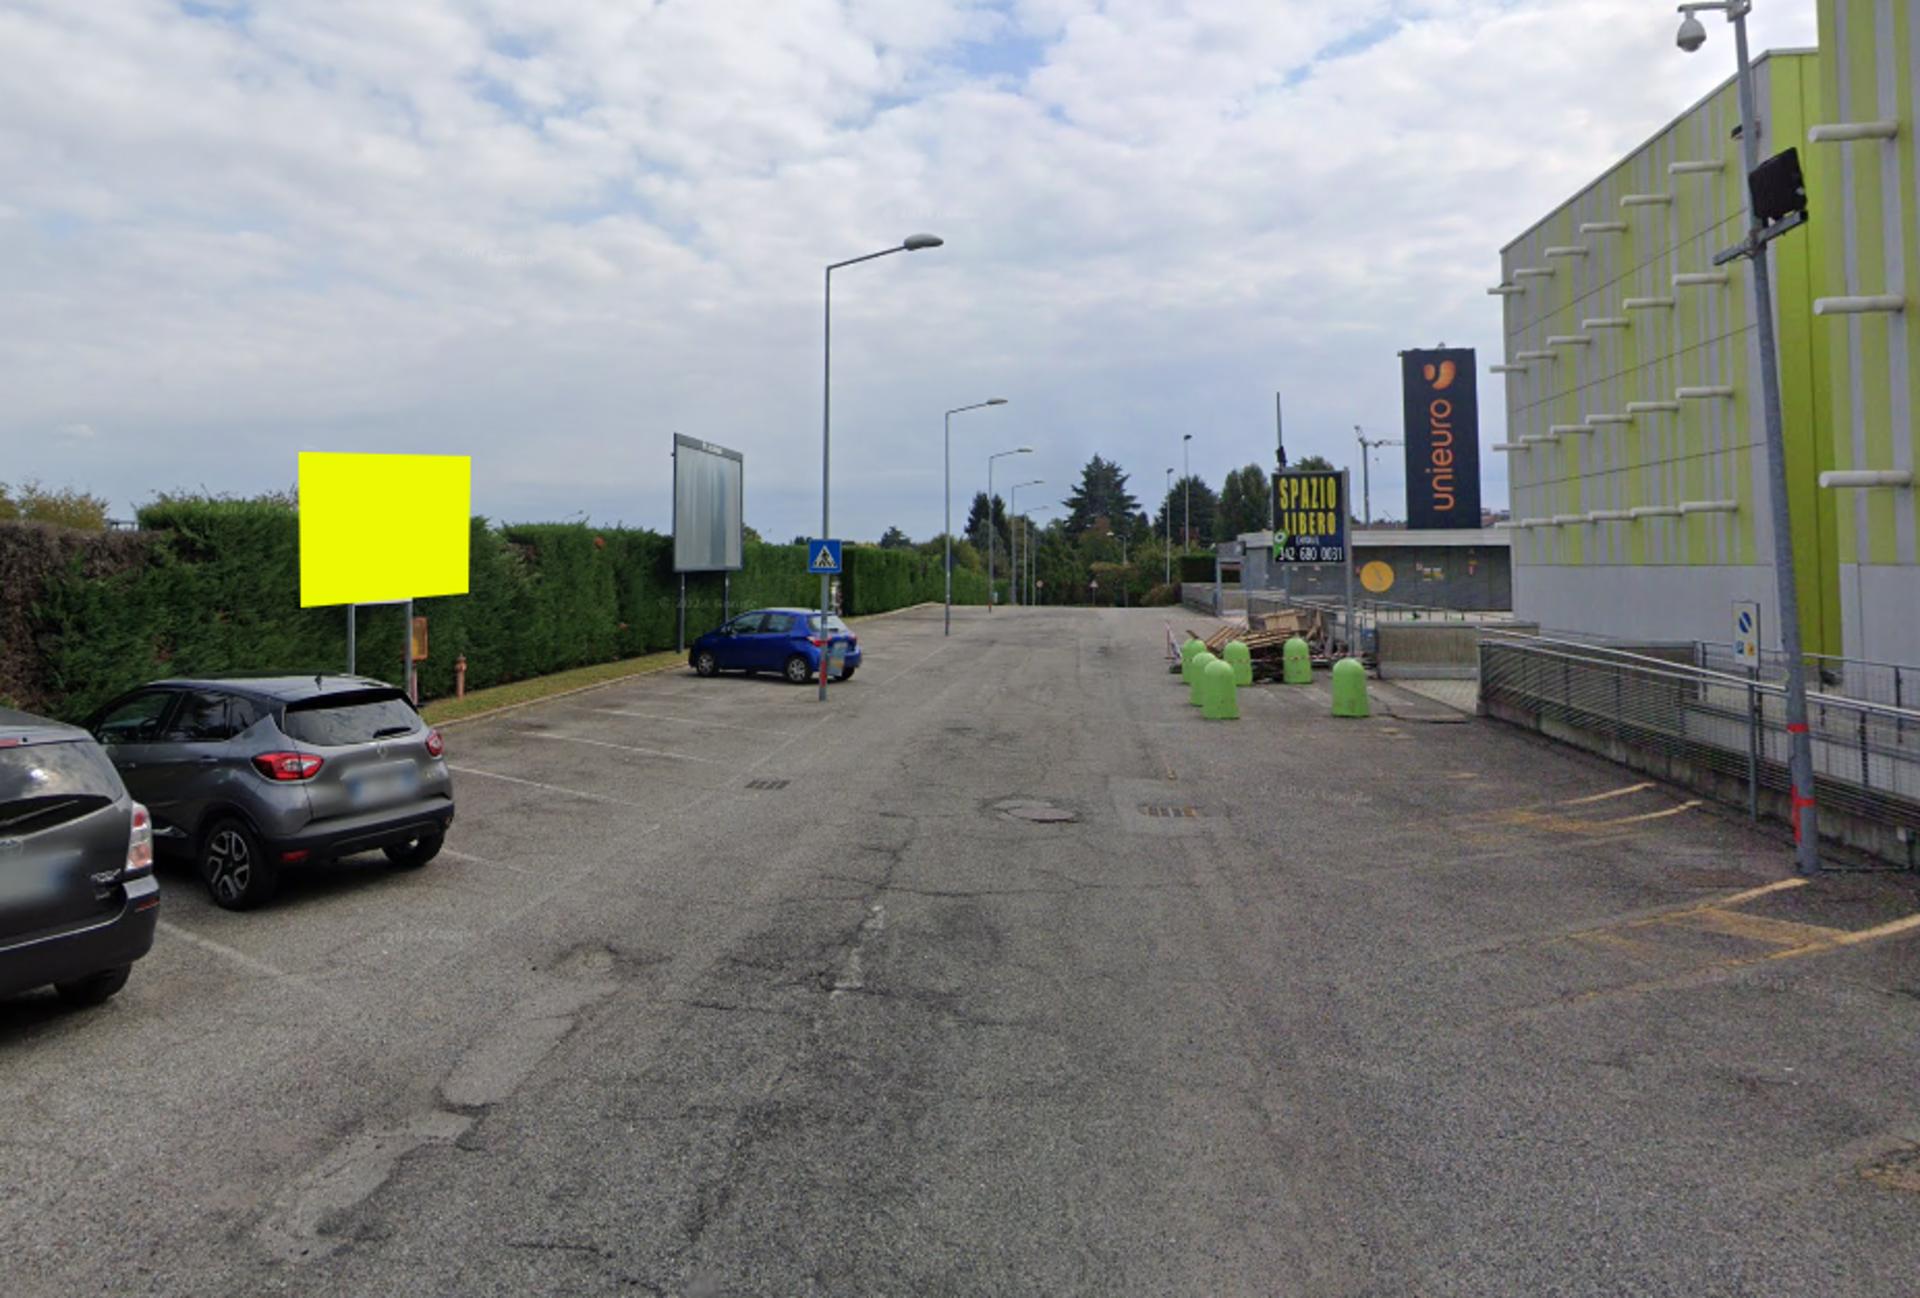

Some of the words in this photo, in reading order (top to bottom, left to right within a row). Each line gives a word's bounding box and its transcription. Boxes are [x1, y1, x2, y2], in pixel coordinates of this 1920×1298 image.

[1425, 399, 1456, 511] unieuro
[1280, 477, 1336, 509] SPAZIO
[1283, 512, 1336, 535] LIBERO
